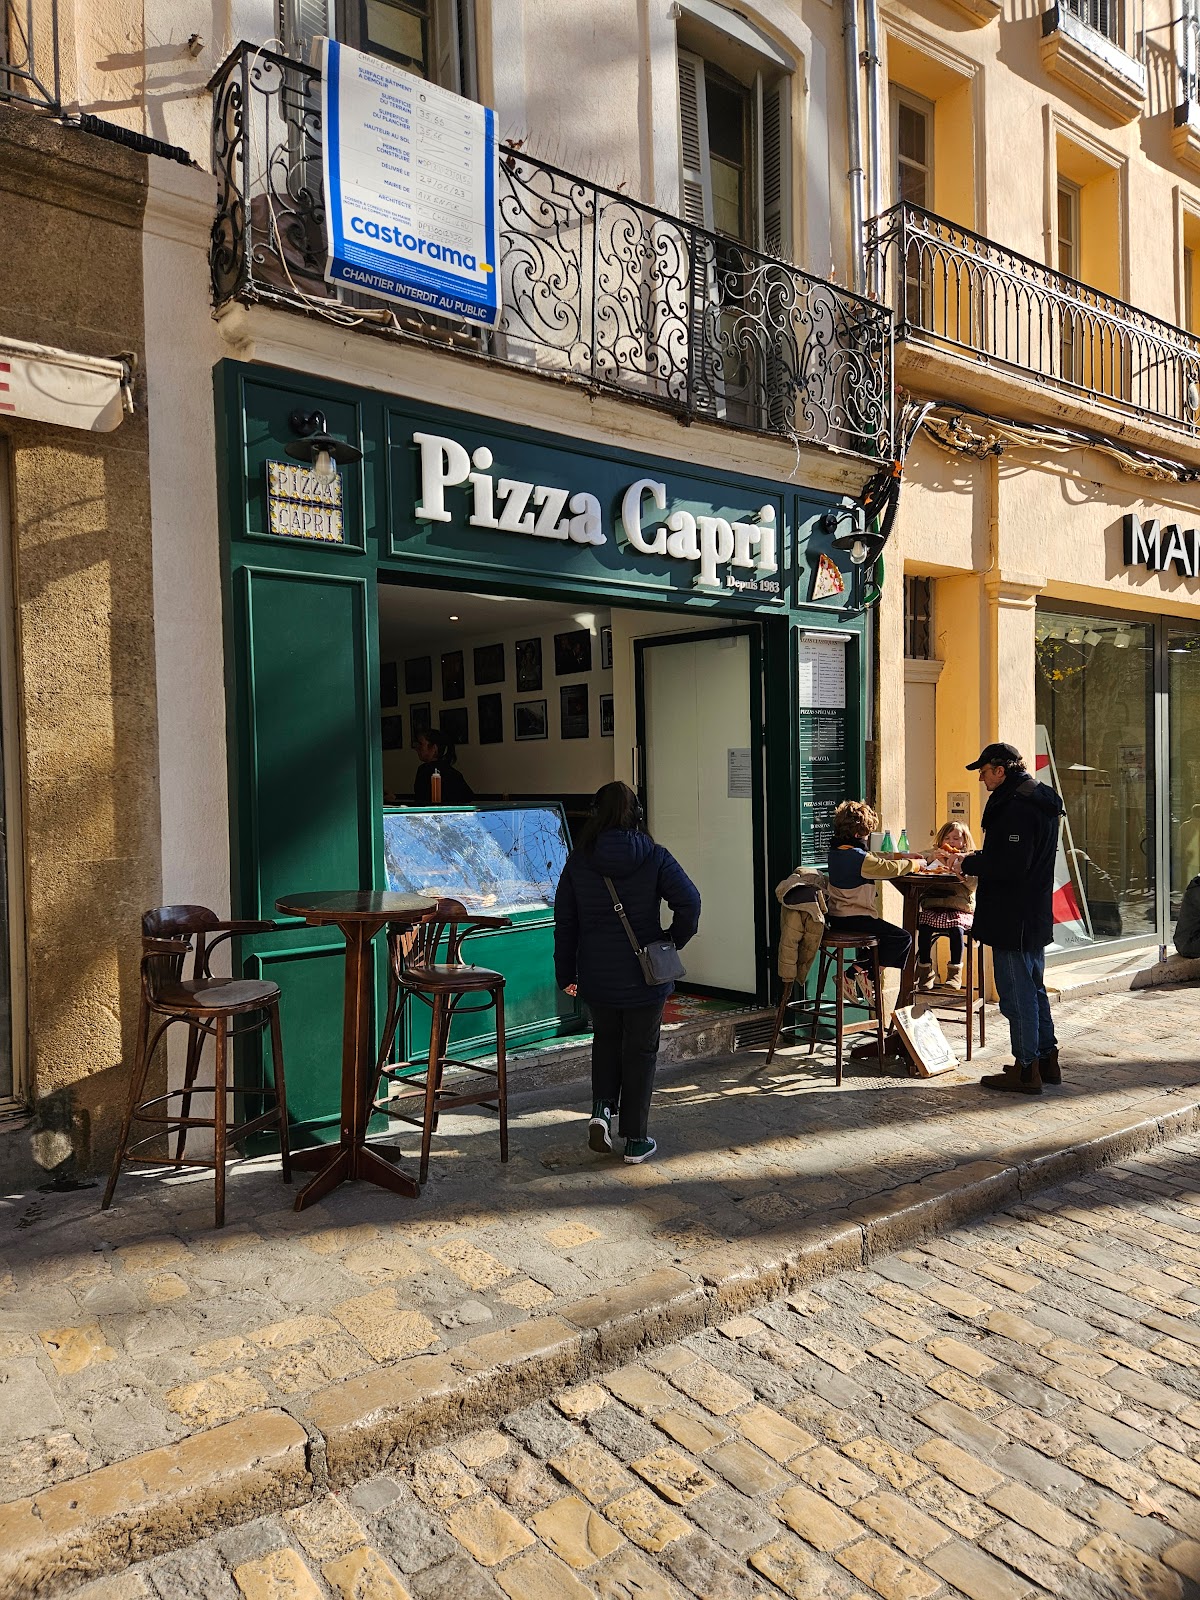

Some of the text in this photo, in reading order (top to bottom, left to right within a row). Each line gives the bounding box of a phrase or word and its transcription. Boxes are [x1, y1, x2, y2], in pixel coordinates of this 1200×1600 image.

[359, 67, 412, 93] SURFACE BÂTIMENT
[381, 93, 412, 109] SUPERFICIE
[389, 100, 412, 115] TERRAIN
[378, 108, 409, 124] SUPERFICIE
[382, 115, 411, 130] PLANCHER
[363, 122, 411, 144] HAUTEUR AU SOL
[376, 147, 411, 163] CONSTRUIRE
[383, 179, 401, 191] MAIRIE
[378, 194, 412, 210] ARCHITECTE
[350, 216, 477, 271] castorama
[342, 267, 487, 319] CHANTIER INTERDIT AU PUBLIC
[277, 471, 333, 498] PIZZA
[413, 431, 778, 587] Pizza Capri
[279, 508, 332, 533] CAPRI
[726, 575, 780, 593] Depuis 1983
